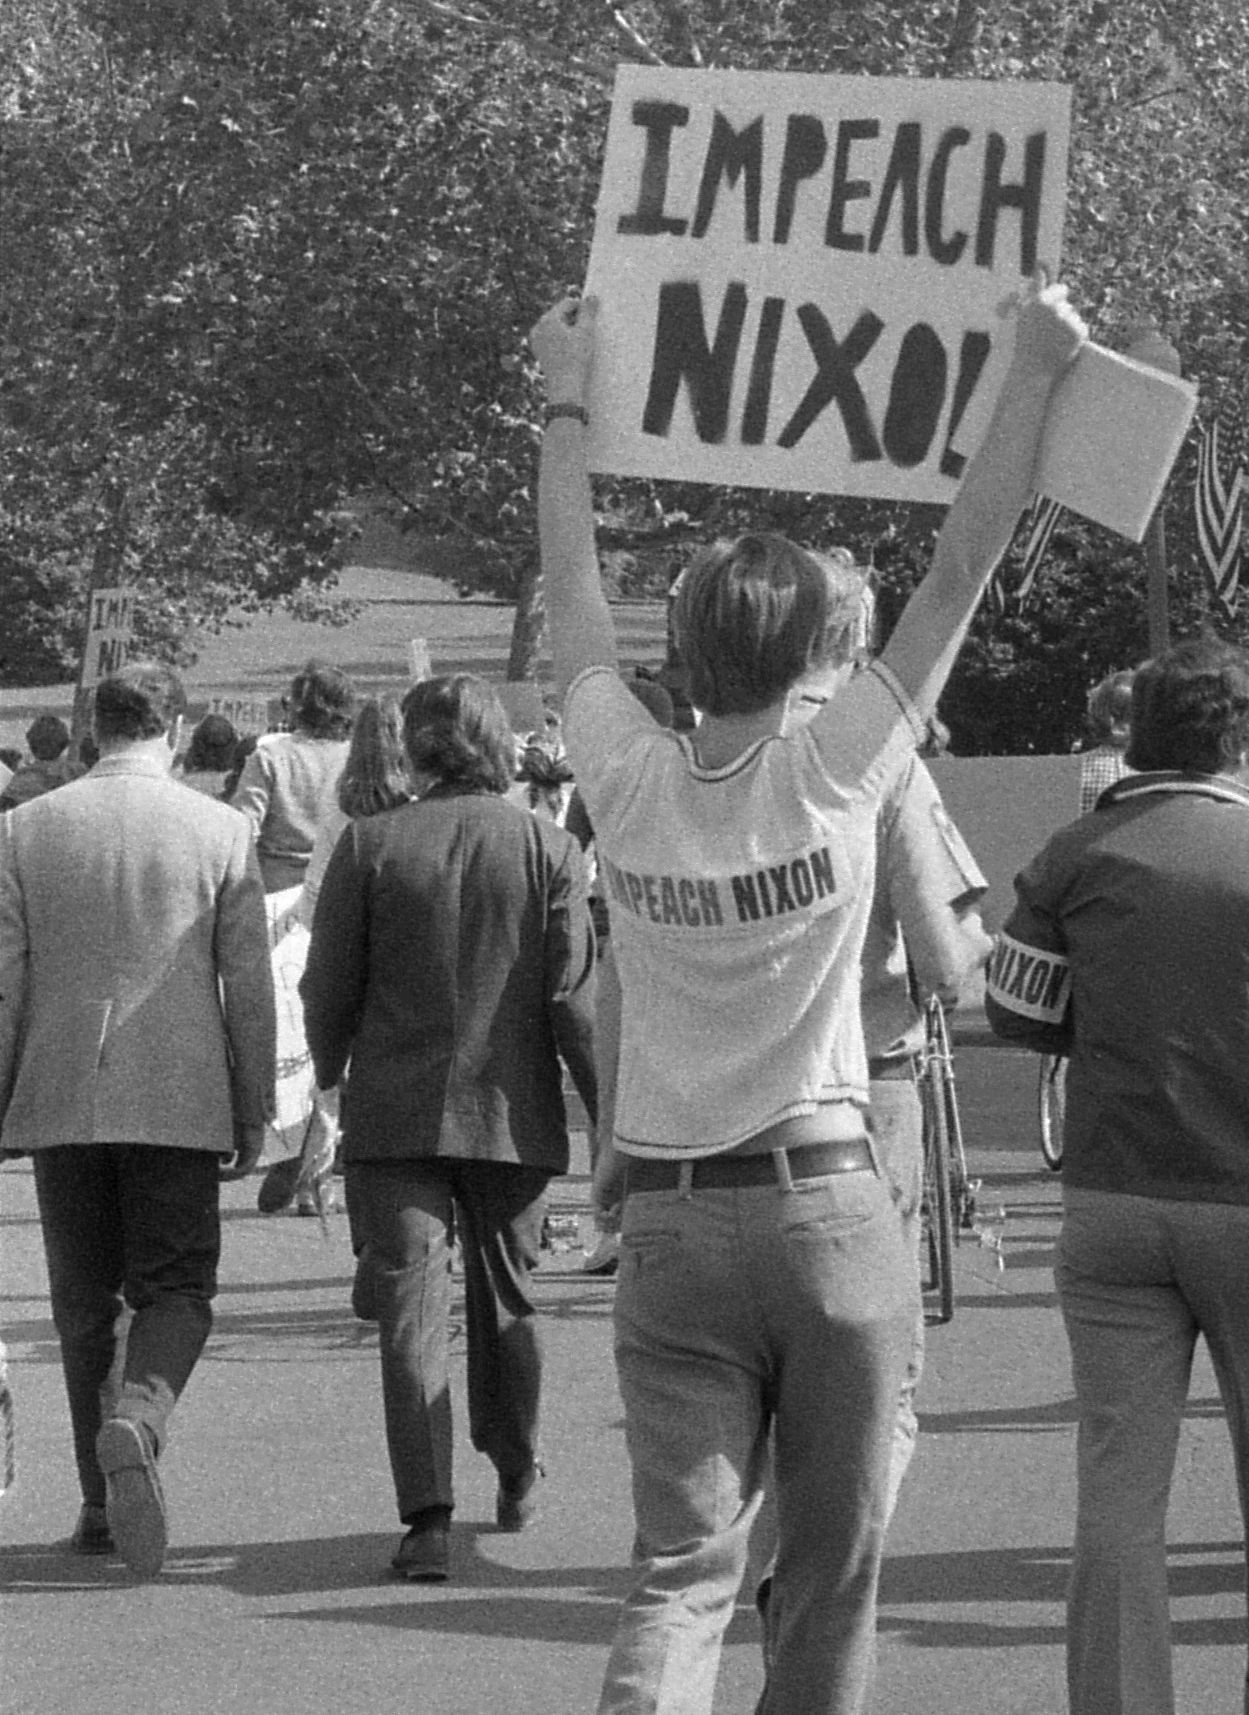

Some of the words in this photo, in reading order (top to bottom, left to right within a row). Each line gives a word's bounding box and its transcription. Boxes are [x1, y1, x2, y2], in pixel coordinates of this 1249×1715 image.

[616, 100, 1047, 276] IMPEACH
[731, 847, 836, 922] NIXON
[992, 942, 1069, 1010] NIXON
